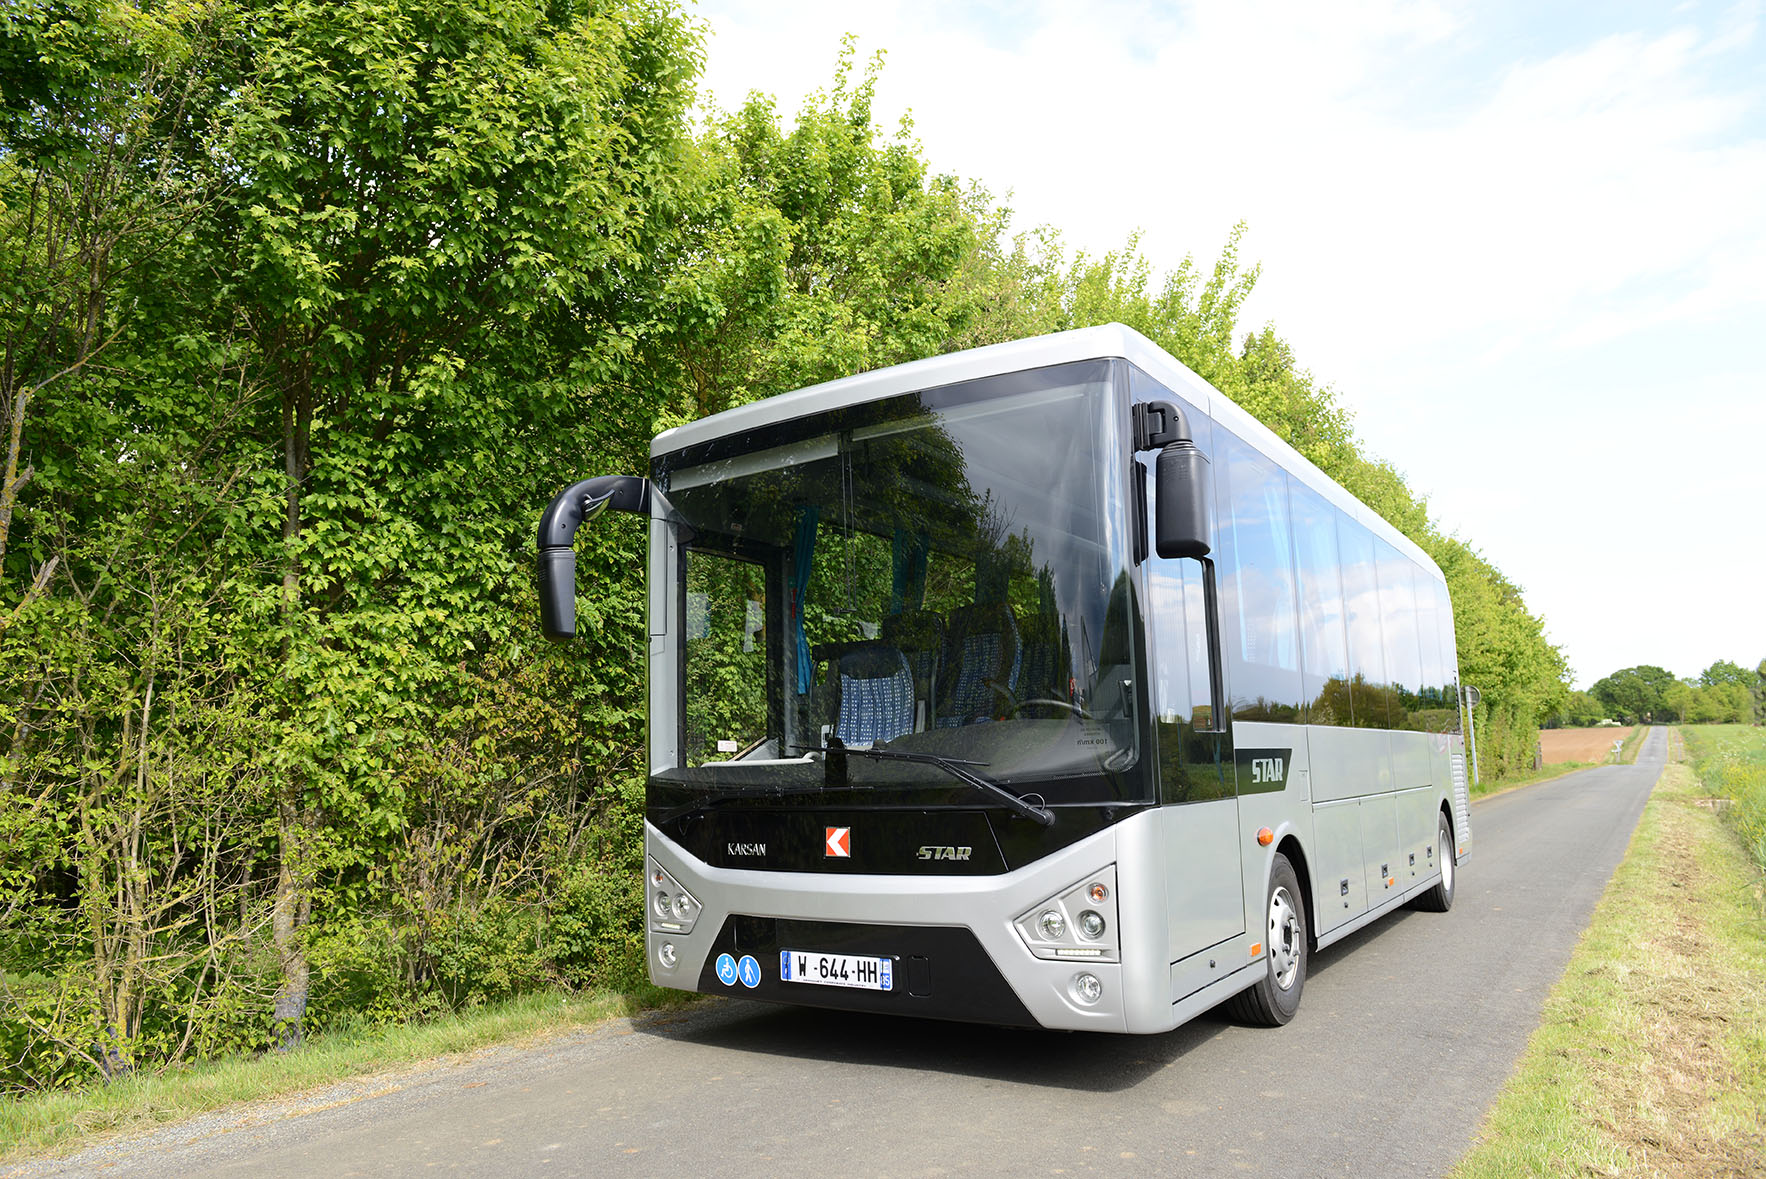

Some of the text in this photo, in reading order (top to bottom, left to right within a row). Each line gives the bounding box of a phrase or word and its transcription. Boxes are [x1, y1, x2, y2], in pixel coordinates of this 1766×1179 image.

[1251, 757, 1284, 783] STAR
[727, 842, 766, 856] KARSAN
[918, 846, 972, 860] STAR
